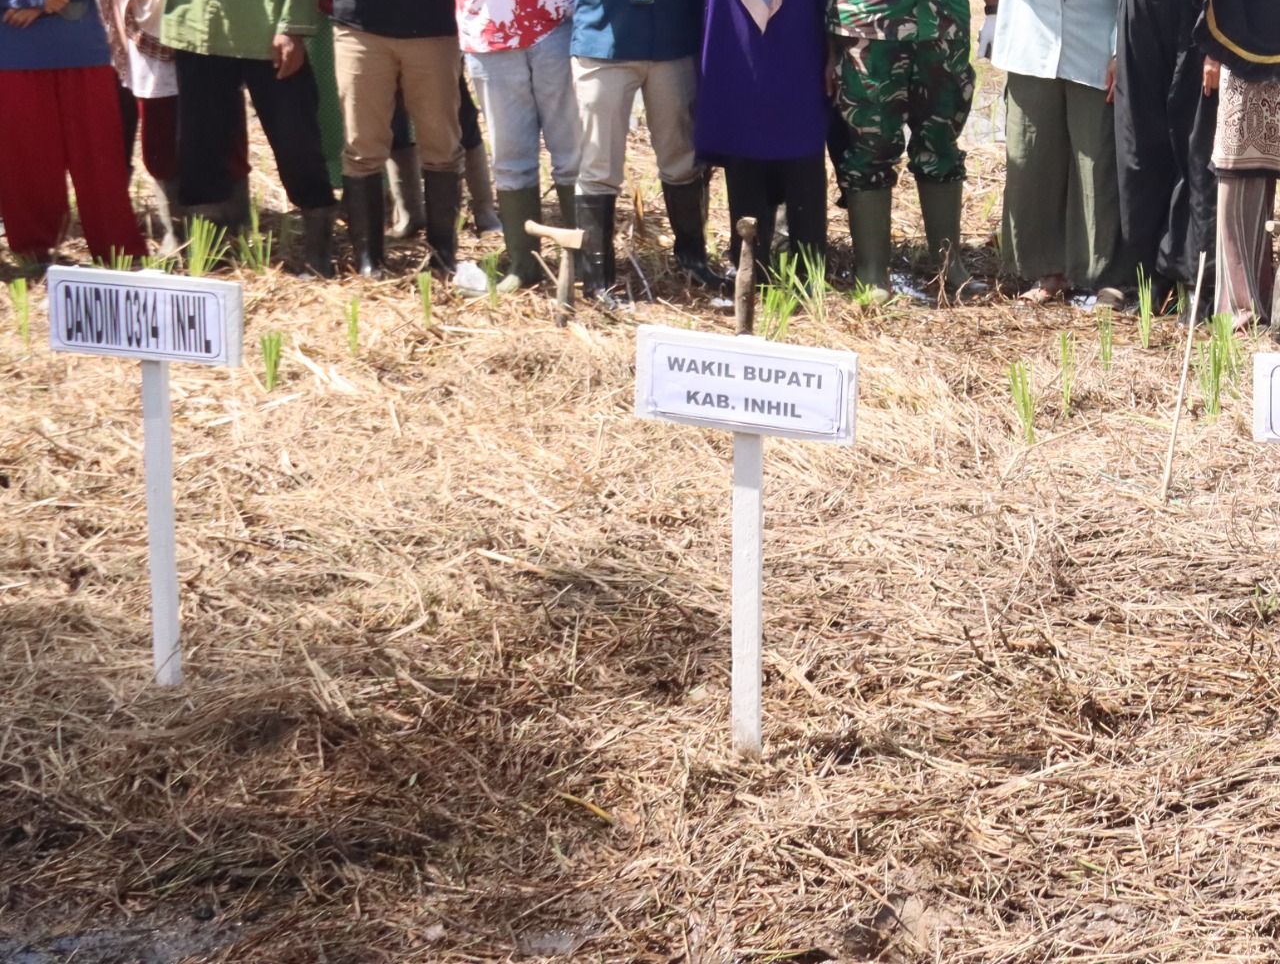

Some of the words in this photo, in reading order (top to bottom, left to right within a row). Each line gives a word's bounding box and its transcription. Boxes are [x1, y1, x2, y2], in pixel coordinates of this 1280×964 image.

[64, 285, 121, 346] DANDIM
[125, 289, 159, 349] 0314
[171, 294, 212, 354] INHIL
[667, 355, 735, 379] WAKIL
[743, 365, 823, 390] BUPATI
[686, 390, 736, 411] KAB.
[744, 397, 802, 419] INHIL
